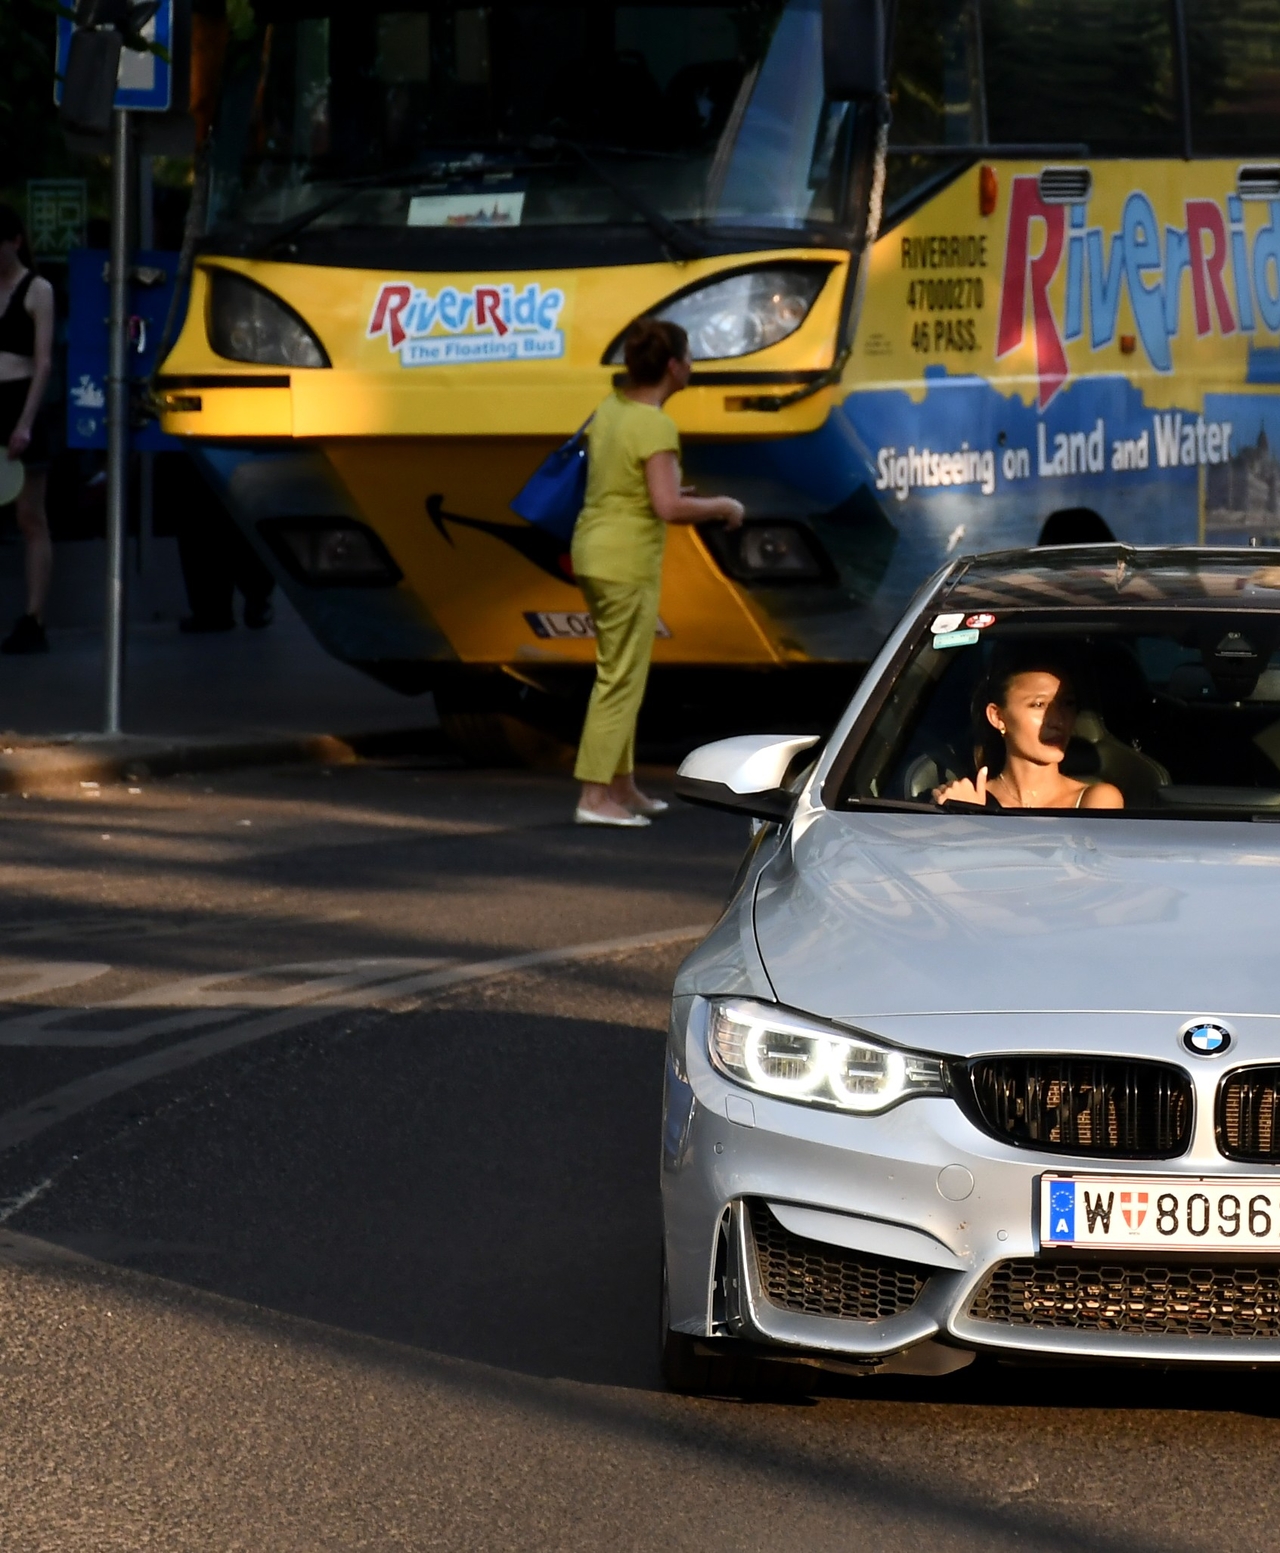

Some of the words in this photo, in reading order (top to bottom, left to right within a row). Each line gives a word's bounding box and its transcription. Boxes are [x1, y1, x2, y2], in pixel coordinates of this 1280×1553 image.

[901, 234, 988, 269] RIVERRIDE
[907, 277, 984, 311] 47000270
[369, 283, 562, 348] RiverRide
[410, 345, 440, 359] The
[445, 340, 518, 358] Floating
[523, 338, 555, 352] Bus
[911, 321, 930, 353] 46
[934, 319, 982, 352] PASS.
[876, 442, 996, 501] Sightseeing
[1003, 447, 1030, 480] on
[1037, 418, 1105, 477] Land
[1112, 430, 1149, 471] and
[1154, 413, 1233, 469] Water
